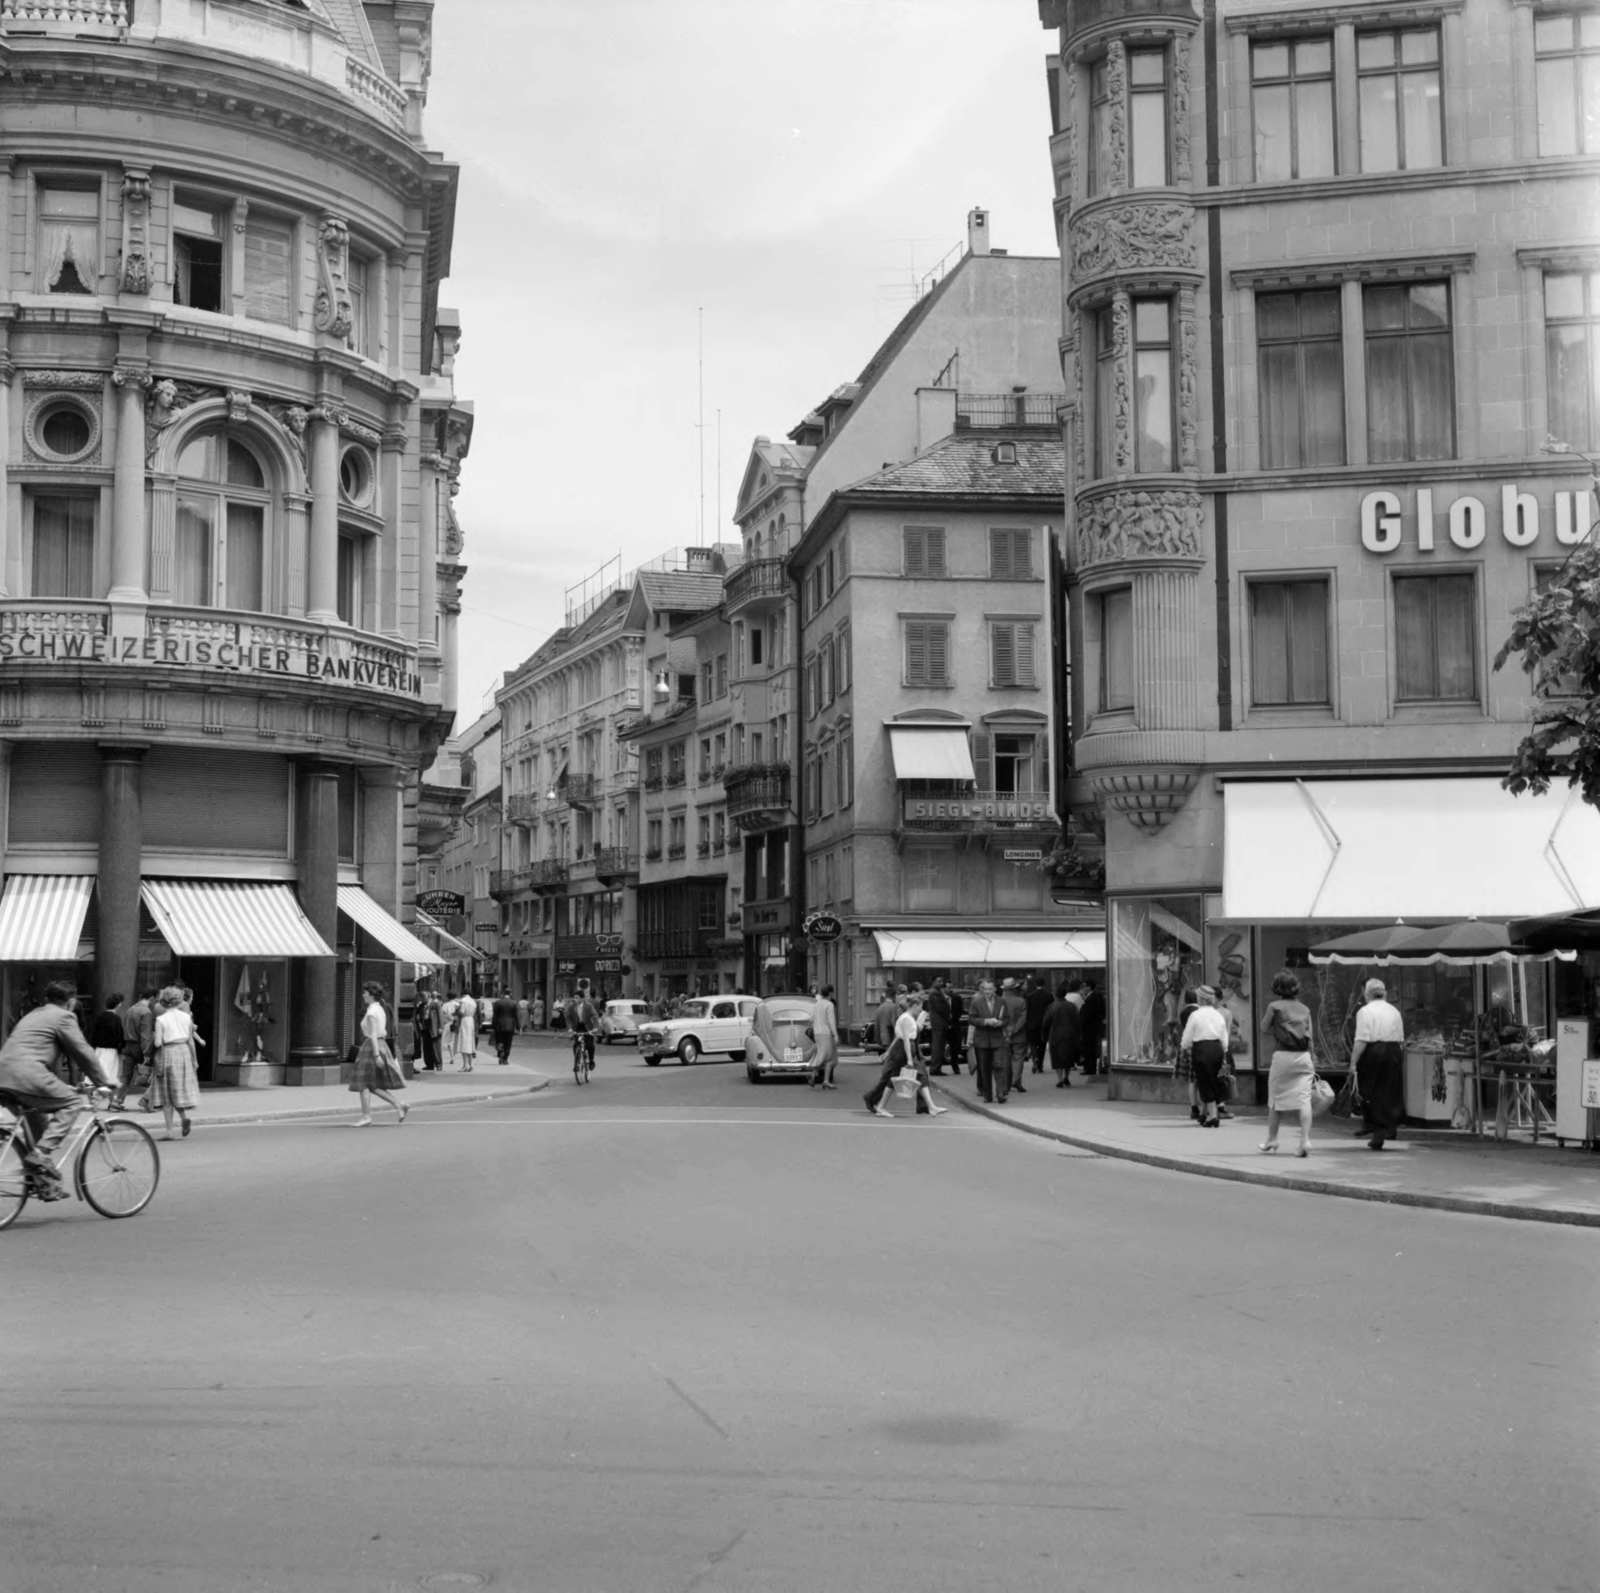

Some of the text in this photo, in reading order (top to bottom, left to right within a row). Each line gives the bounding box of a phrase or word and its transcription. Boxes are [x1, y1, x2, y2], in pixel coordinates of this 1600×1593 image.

[0, 634, 421, 696] SCHWEIZERISCHER BANKVEREIN
[425, 891, 456, 900] UHREN
